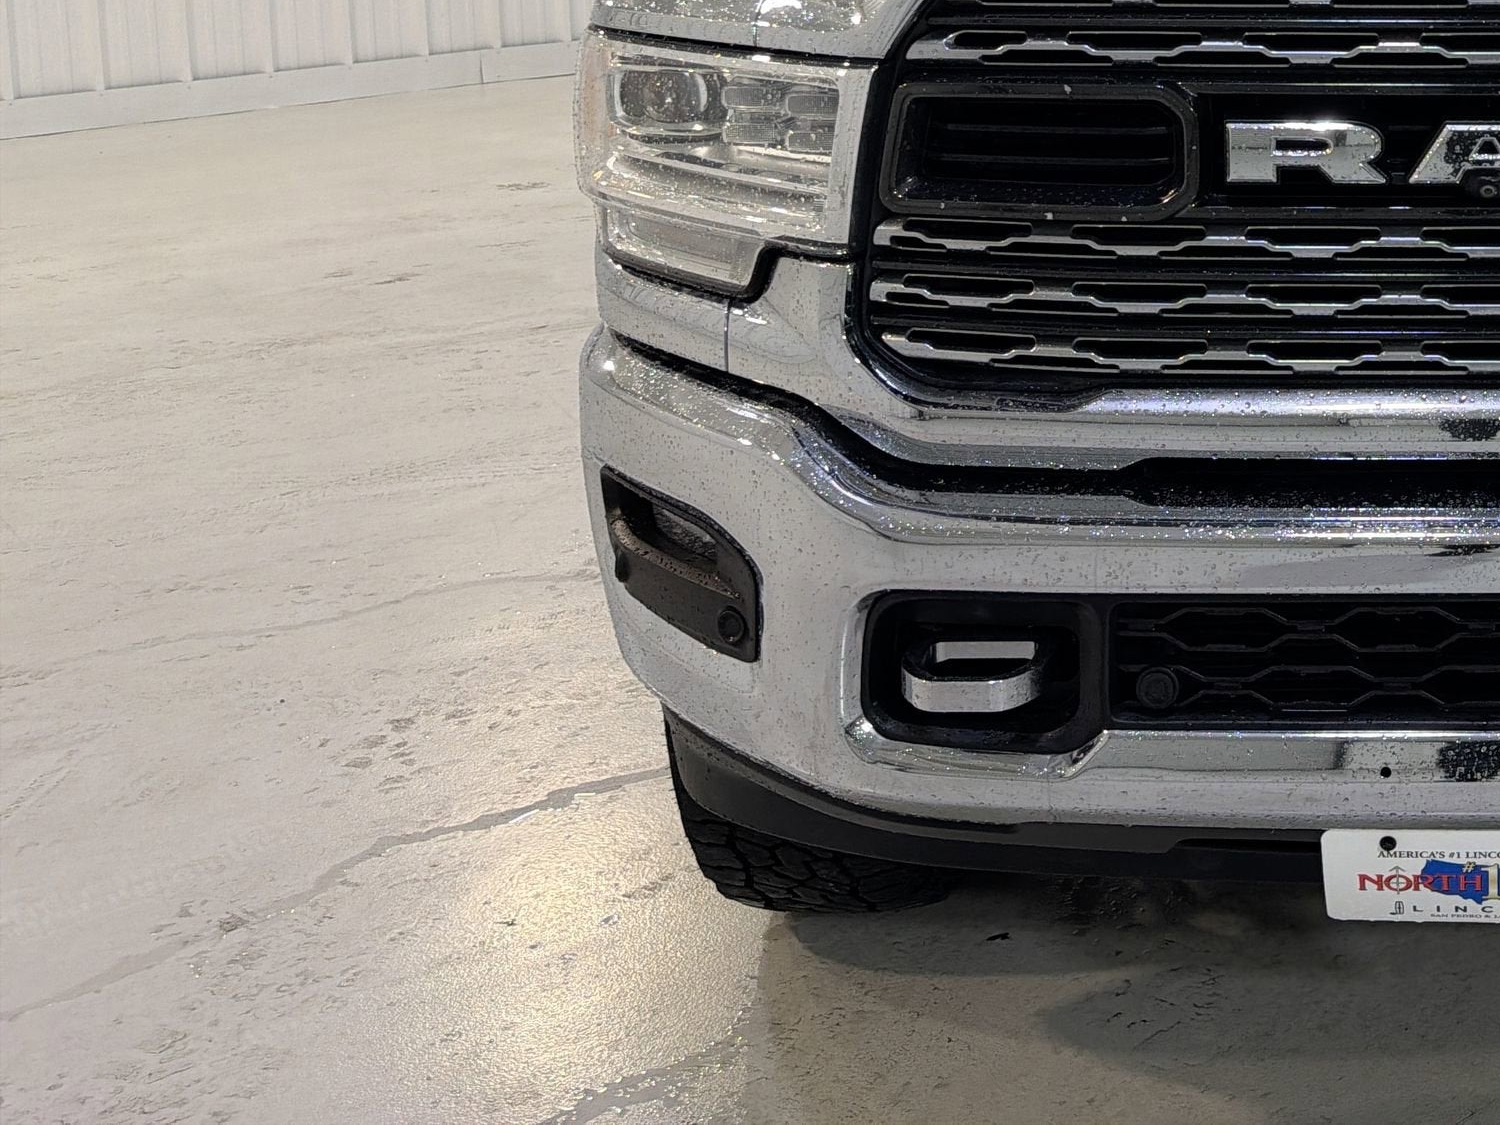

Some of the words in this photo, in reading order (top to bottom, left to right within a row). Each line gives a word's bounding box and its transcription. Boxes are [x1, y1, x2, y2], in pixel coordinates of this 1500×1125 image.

[1377, 850, 1446, 859] AMERICA'S
[1448, 851, 1461, 859] #1
[1357, 873, 1484, 892] NORTH
